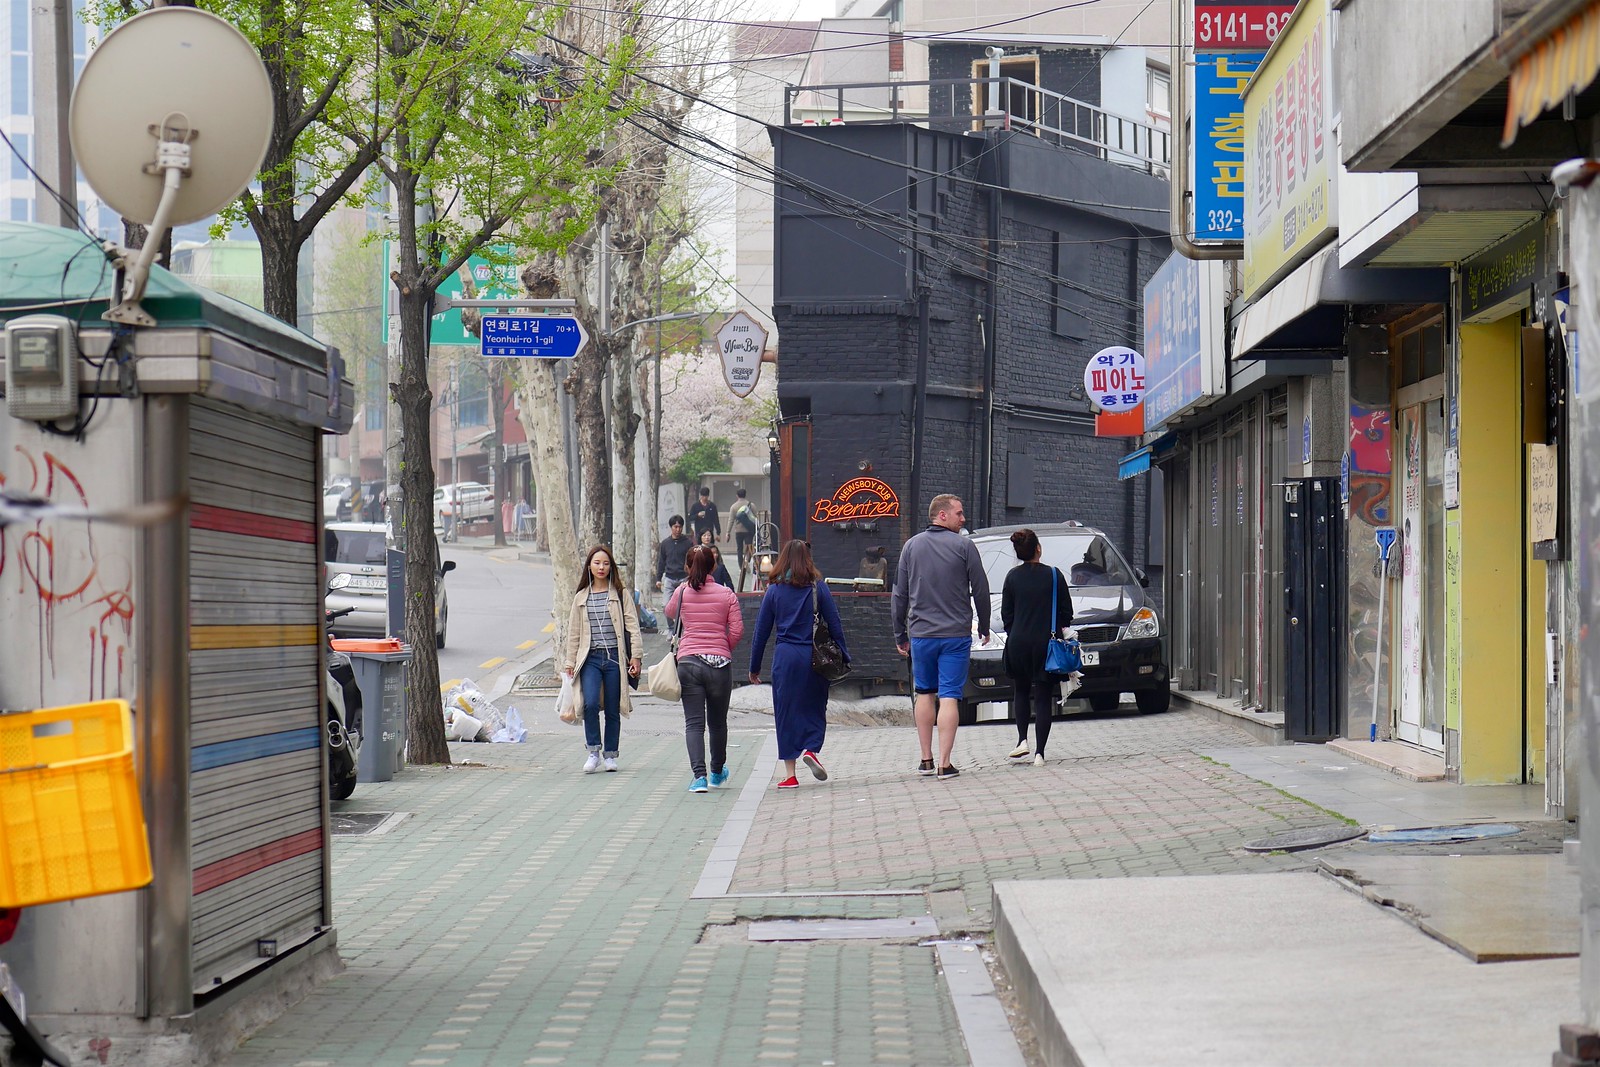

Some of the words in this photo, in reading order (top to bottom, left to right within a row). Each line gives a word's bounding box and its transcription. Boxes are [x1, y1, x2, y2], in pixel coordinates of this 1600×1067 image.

[1274, 17, 1324, 208] 동물병원
[1208, 210, 1244, 232] 332-
[485, 320, 540, 333] 연희로1길
[486, 335, 533, 344] Yeonhui-ro
[535, 335, 554, 345] 1-gil
[1097, 353, 1136, 366] 악기
[1091, 367, 1145, 392] 피아노
[1101, 393, 1139, 405] 총판
[838, 480, 878, 502] NEWSBOY
[876, 484, 891, 500] PUB
[811, 498, 899, 522] Berentzen
